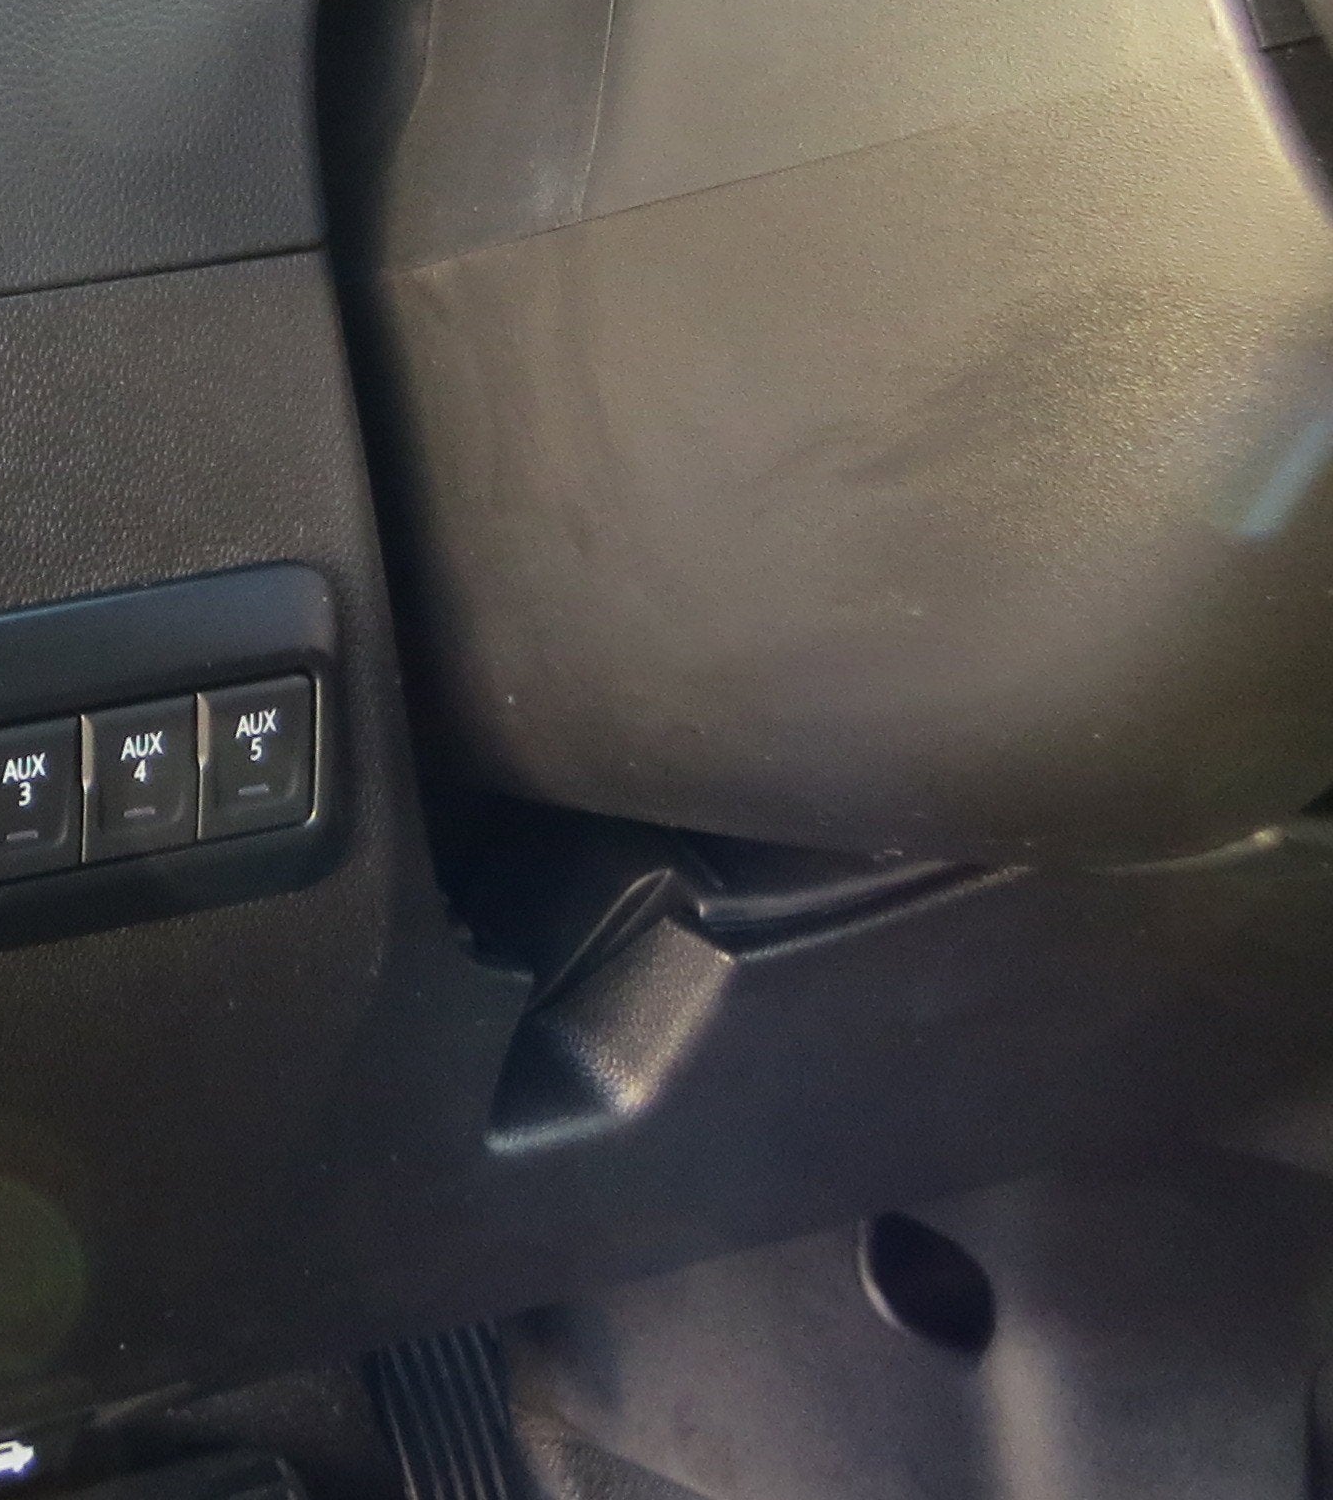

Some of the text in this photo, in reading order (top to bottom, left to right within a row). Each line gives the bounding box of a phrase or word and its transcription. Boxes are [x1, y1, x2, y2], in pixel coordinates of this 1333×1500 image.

[235, 708, 277, 740] AUX
[120, 730, 163, 763] AUX
[250, 736, 263, 761] 5
[2, 752, 46, 784] AUX
[133, 758, 147, 783] 4
[18, 781, 32, 807] 3
